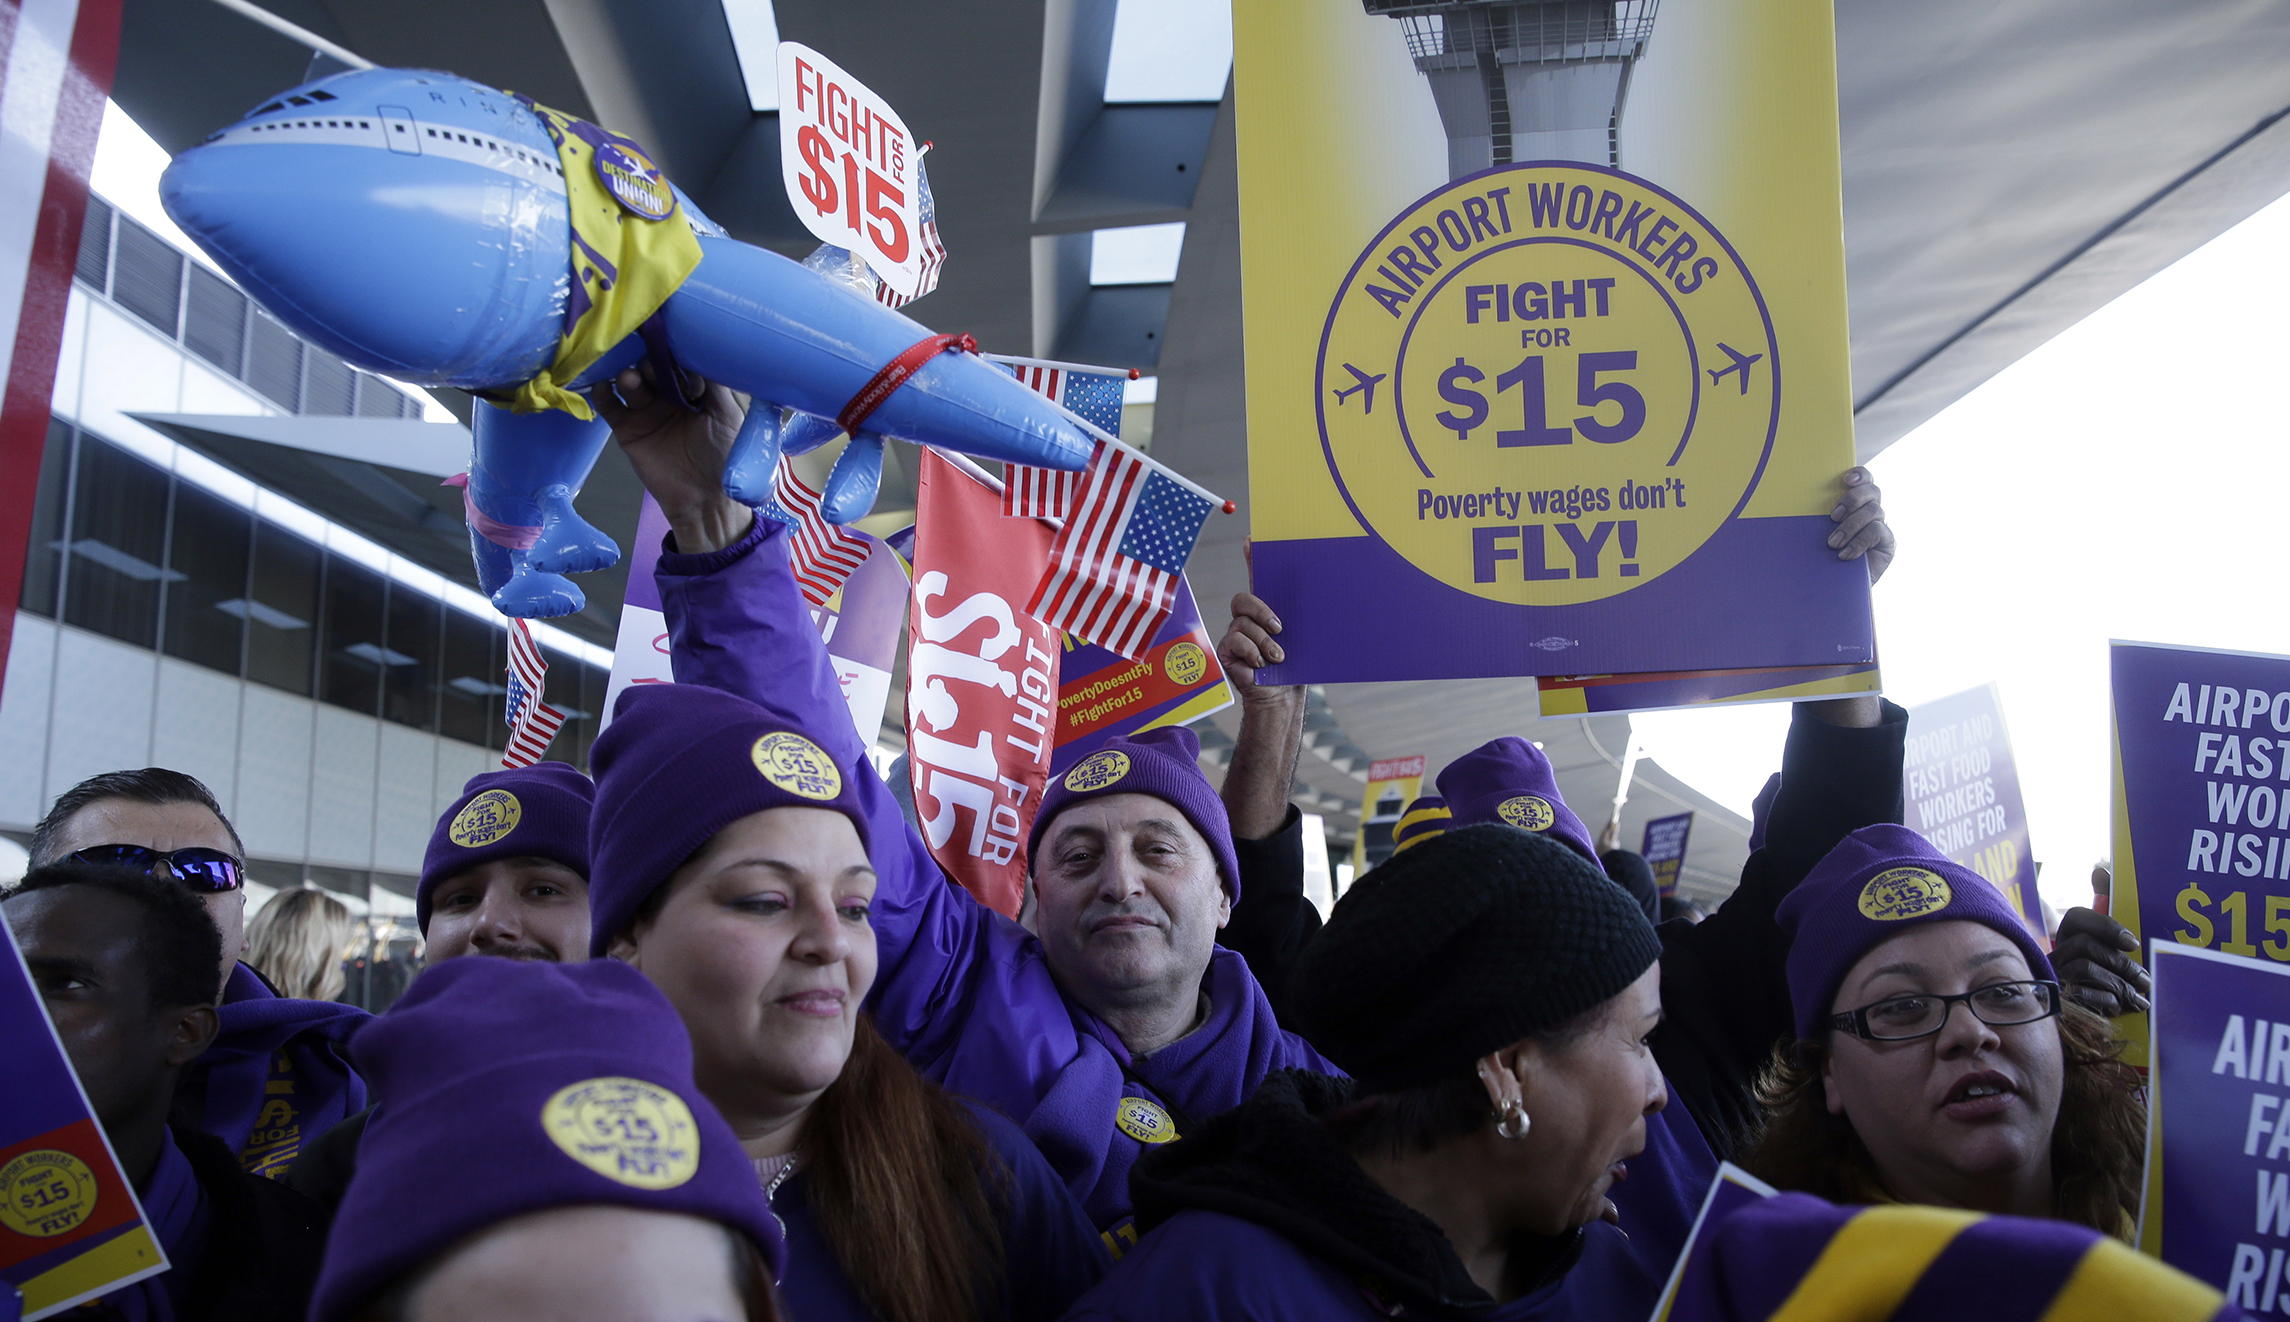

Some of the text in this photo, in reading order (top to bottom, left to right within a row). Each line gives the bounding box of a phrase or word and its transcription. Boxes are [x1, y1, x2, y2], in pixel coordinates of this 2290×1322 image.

[796, 56, 903, 172] FIGHT
[892, 136, 904, 184] FOR
[602, 159, 673, 205] DESTINATION
[612, 175, 664, 216] UNION!
[797, 124, 909, 264] $15
[1364, 182, 1719, 319] AIRPORT WORKERS
[1465, 277, 1616, 324] FIGHT
[1521, 328, 1571, 349] FOR
[1435, 350, 1646, 449] $15
[1417, 478, 1686, 520] Poverty wages don't
[1472, 520, 1640, 583] FLY!
[1176, 658, 1195, 671] $15
[1070, 687, 1143, 727] #FightFor15
[982, 616, 1053, 866] FIGHT FOR
[1962, 713, 1993, 751] AND
[1909, 746, 1991, 800] FAST FOOD
[467, 812, 497, 829] $15
[1917, 777, 1996, 830] WORKERS
[1977, 804, 2007, 841] FOR
[1882, 886, 1923, 904] $15
[2174, 882, 2290, 962] $15
[1128, 1109, 1158, 1129] $15
[1137, 1105, 1158, 1118] FIGHT
[1126, 1124, 1150, 1141] FLY!
[21, 1181, 70, 1209] $15
[41, 1212, 80, 1234] FLY!
